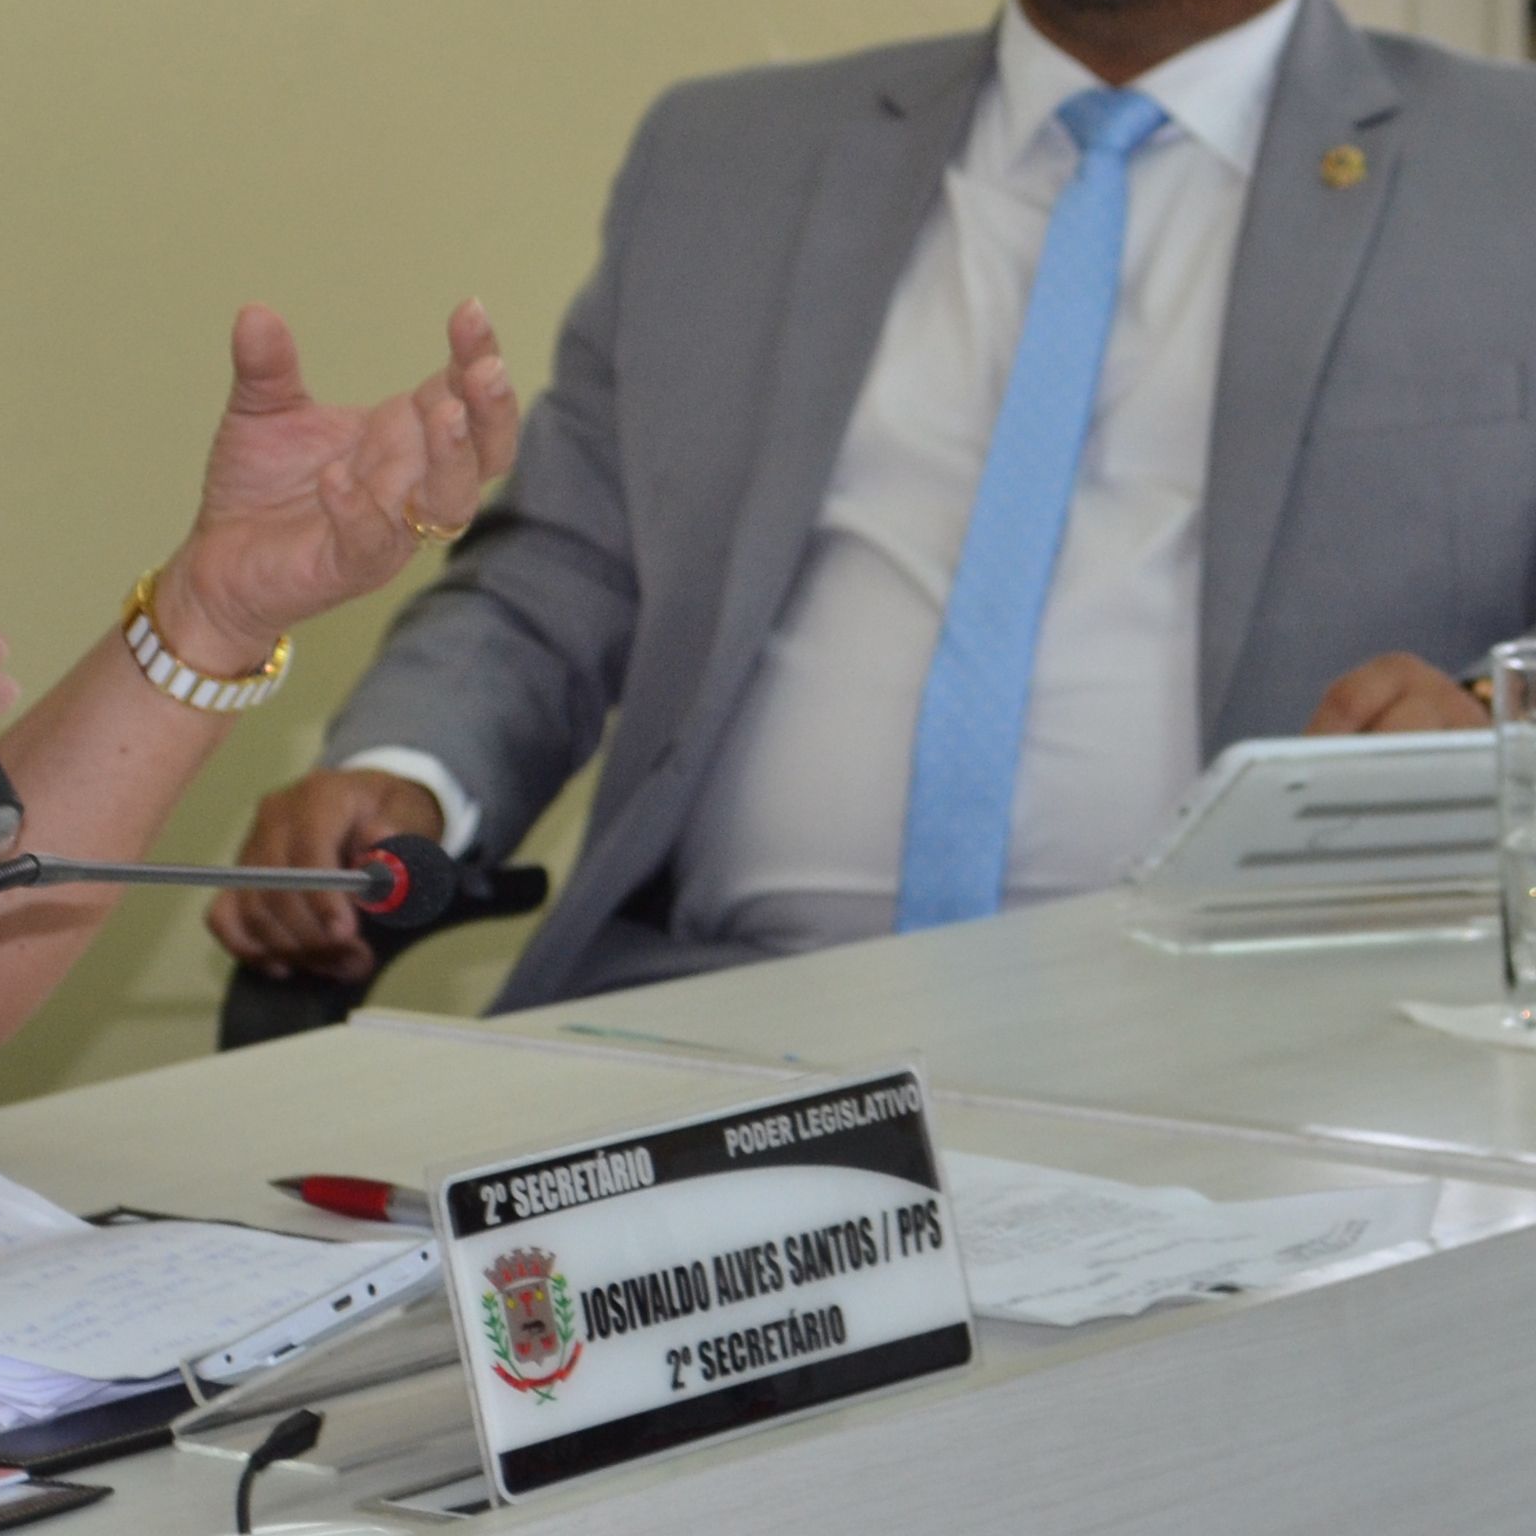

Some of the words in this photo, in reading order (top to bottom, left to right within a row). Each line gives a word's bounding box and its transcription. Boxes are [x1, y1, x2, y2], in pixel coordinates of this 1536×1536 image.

[723, 1114, 795, 1158] PODER
[794, 1083, 922, 1141] LEGISLATIVO
[509, 1146, 656, 1218] SECRETÁRIO
[580, 1260, 711, 1342] JOSIVALDO
[712, 1241, 784, 1307] ALVES
[784, 1216, 878, 1287] SANTOS
[882, 1210, 891, 1263] /
[896, 1198, 943, 1258] PPS
[698, 1305, 847, 1382] SECRETÁRIO
